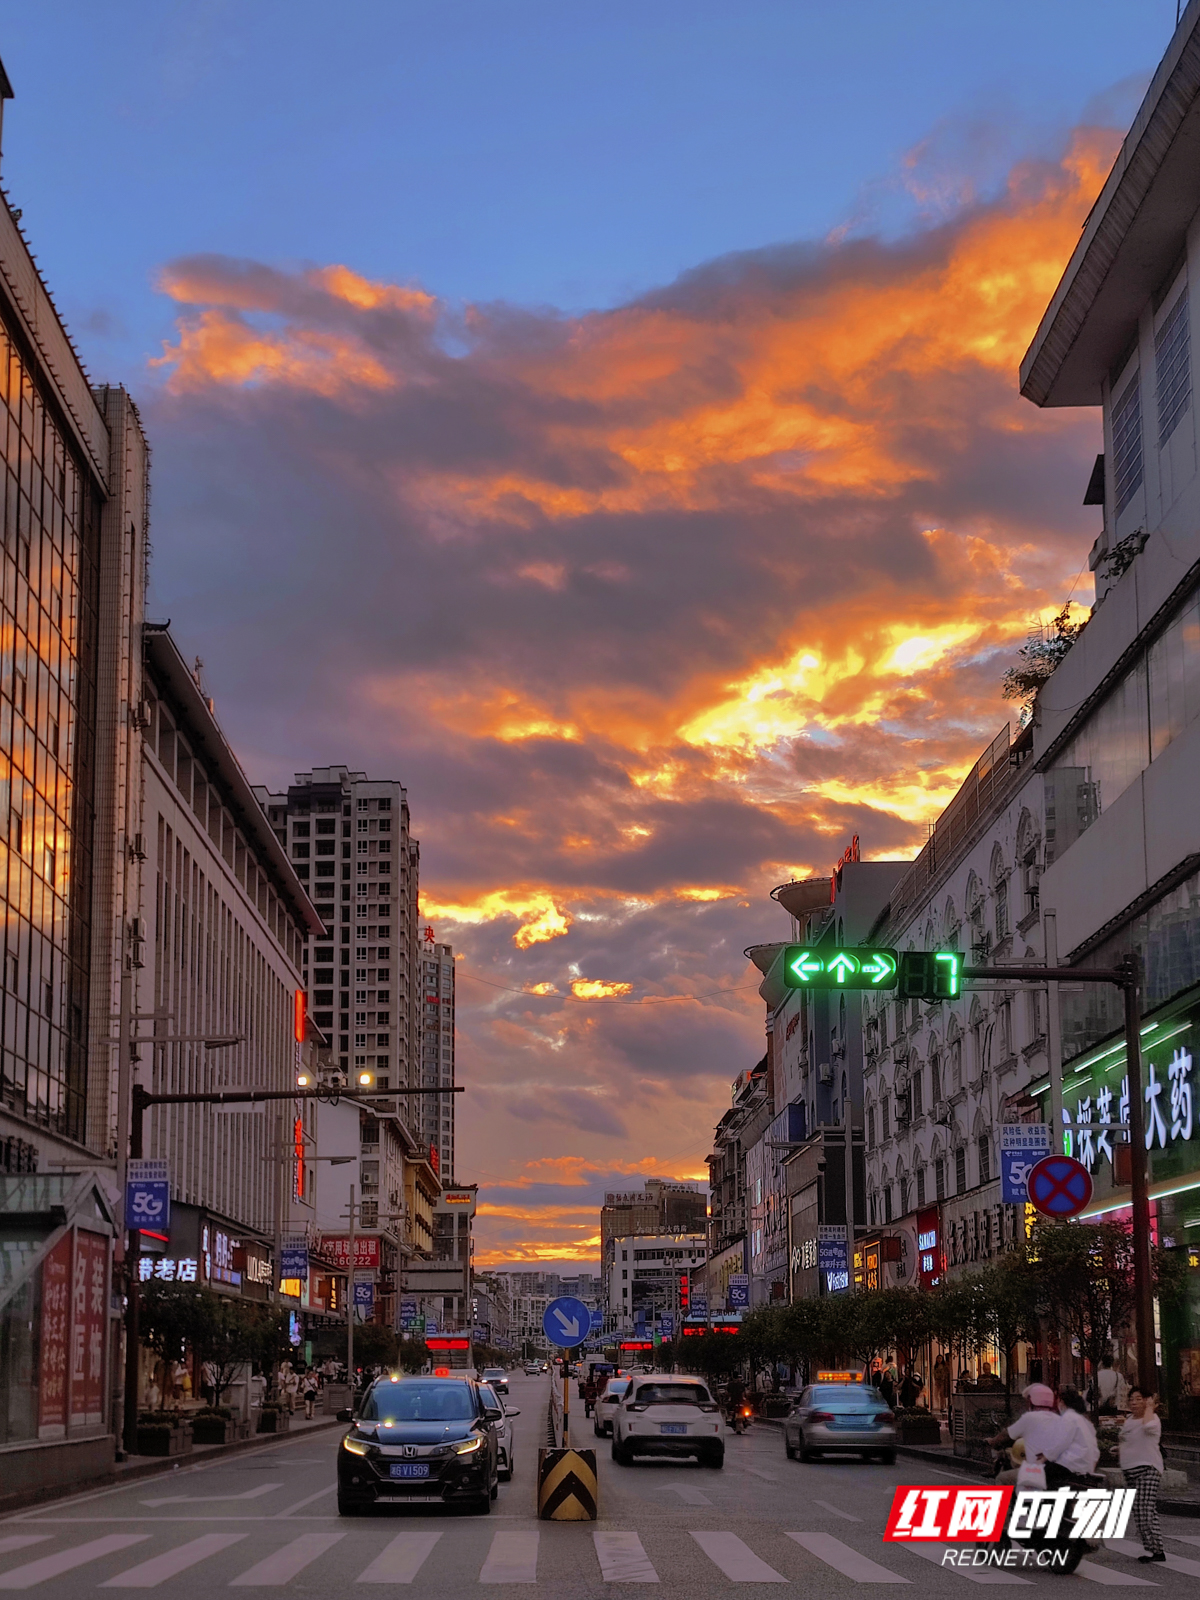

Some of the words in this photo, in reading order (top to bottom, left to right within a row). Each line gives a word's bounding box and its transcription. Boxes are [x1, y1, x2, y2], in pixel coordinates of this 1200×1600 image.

[935, 952, 957, 996] 7
[1002, 1126, 1047, 1135] 风险低、收益高
[1003, 1137, 1047, 1147] 这种明显是圈套
[132, 1191, 163, 1216] 5G
[356, 1286, 371, 1298] 5G
[731, 1288, 746, 1300] 5G
